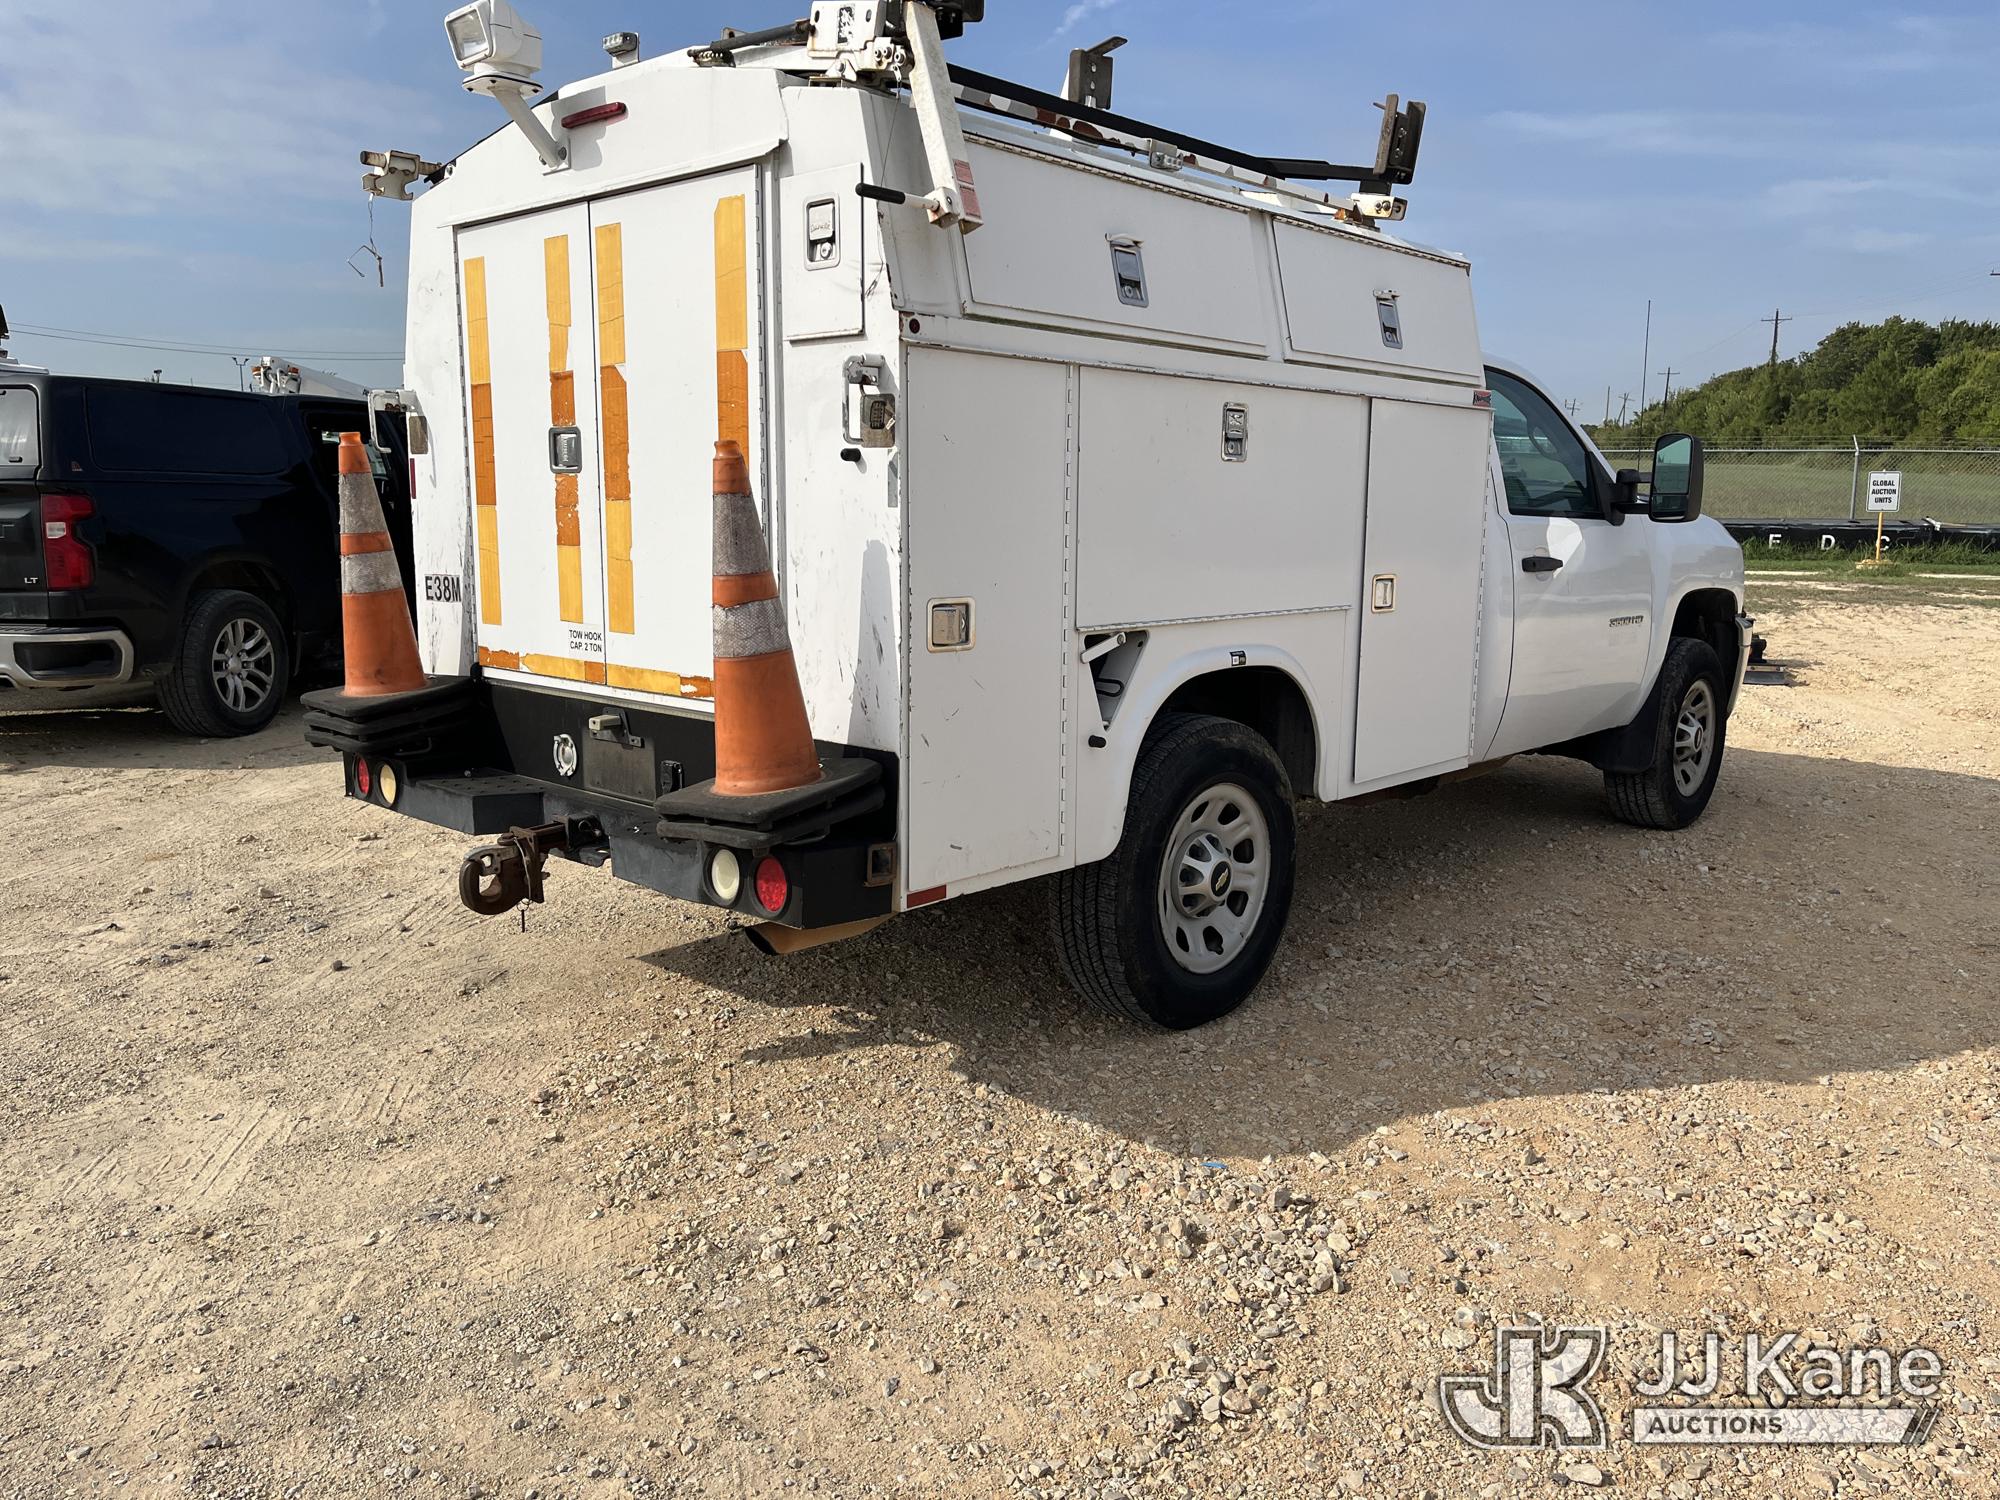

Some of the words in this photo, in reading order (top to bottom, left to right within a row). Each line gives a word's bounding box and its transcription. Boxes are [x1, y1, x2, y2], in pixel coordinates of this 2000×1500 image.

[1821, 534, 1836, 551] D
[425, 576, 461, 602] E38M
[569, 629, 583, 639] TOW
[584, 631, 602, 641] HOOK
[584, 642, 589, 651] 2
[589, 642, 602, 652] TON
